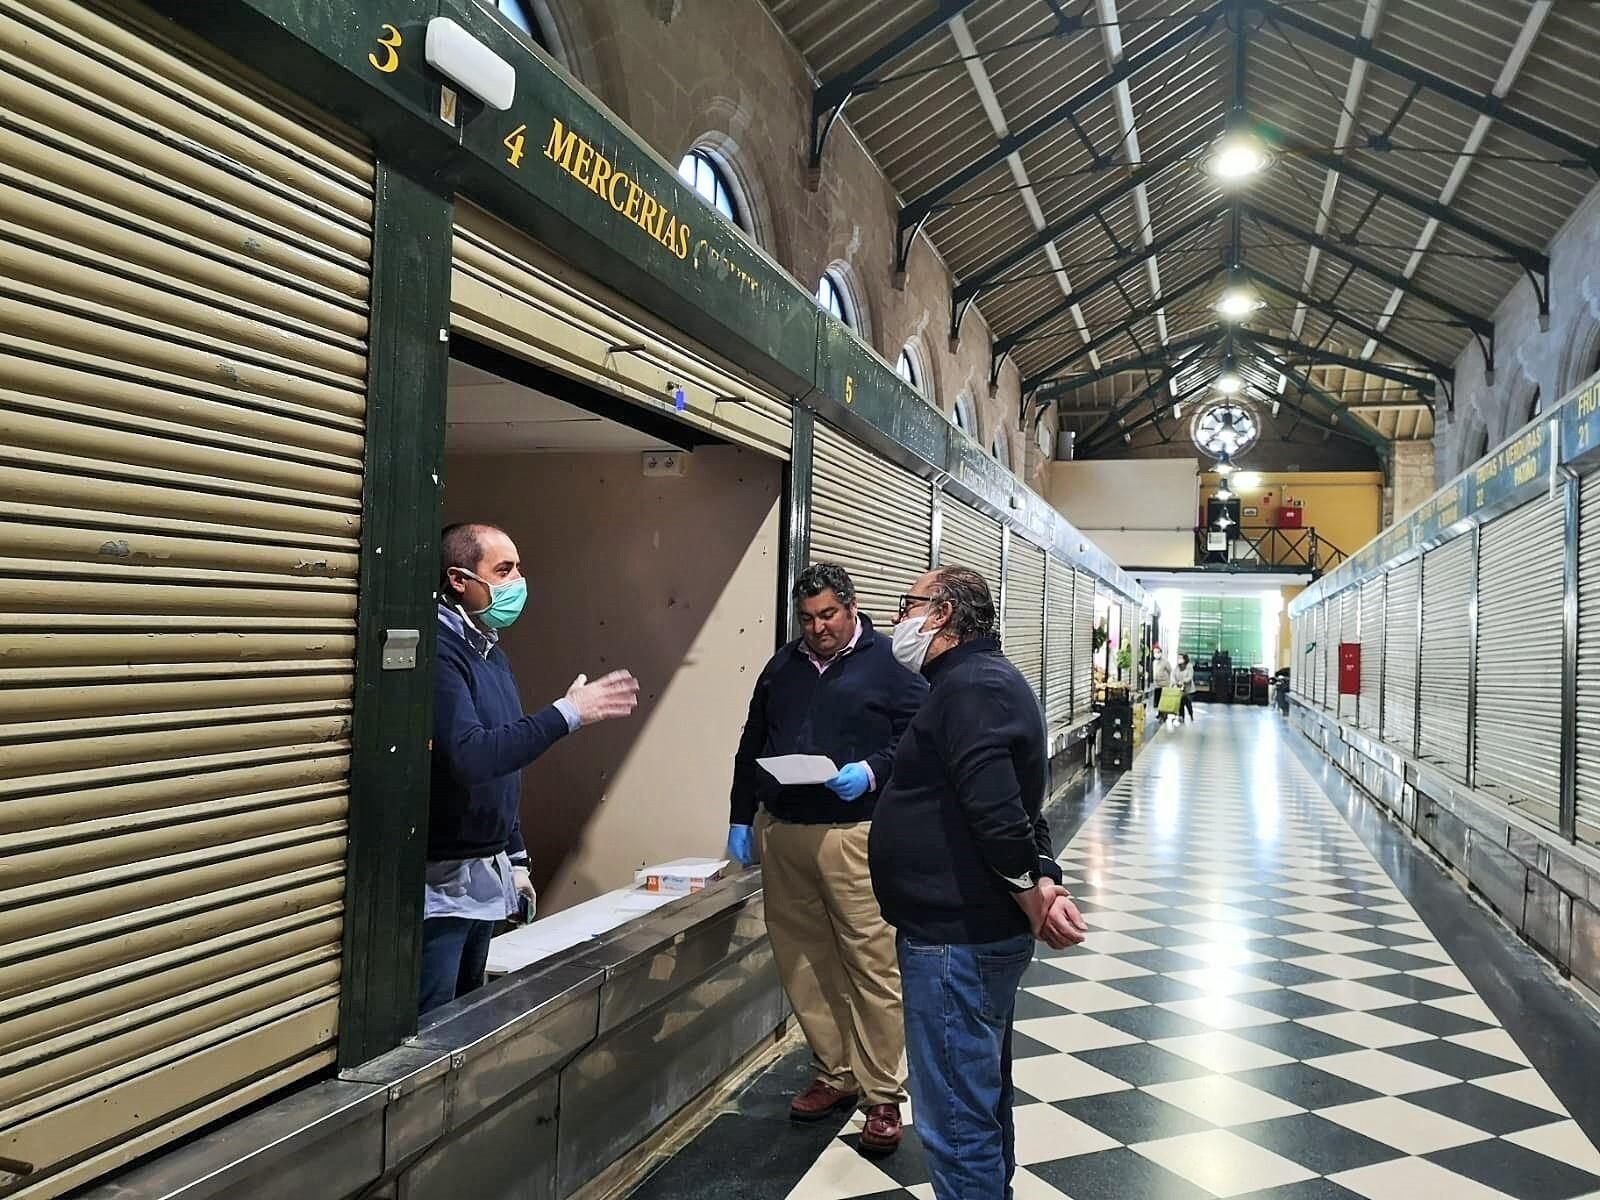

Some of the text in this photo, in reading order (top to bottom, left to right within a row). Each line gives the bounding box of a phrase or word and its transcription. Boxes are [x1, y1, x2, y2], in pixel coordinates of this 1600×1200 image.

[368, 23, 402, 73] 3
[503, 117, 690, 260] 4 MERCERIAS
[845, 375, 854, 404] 5
[1577, 422, 1589, 449] 21
